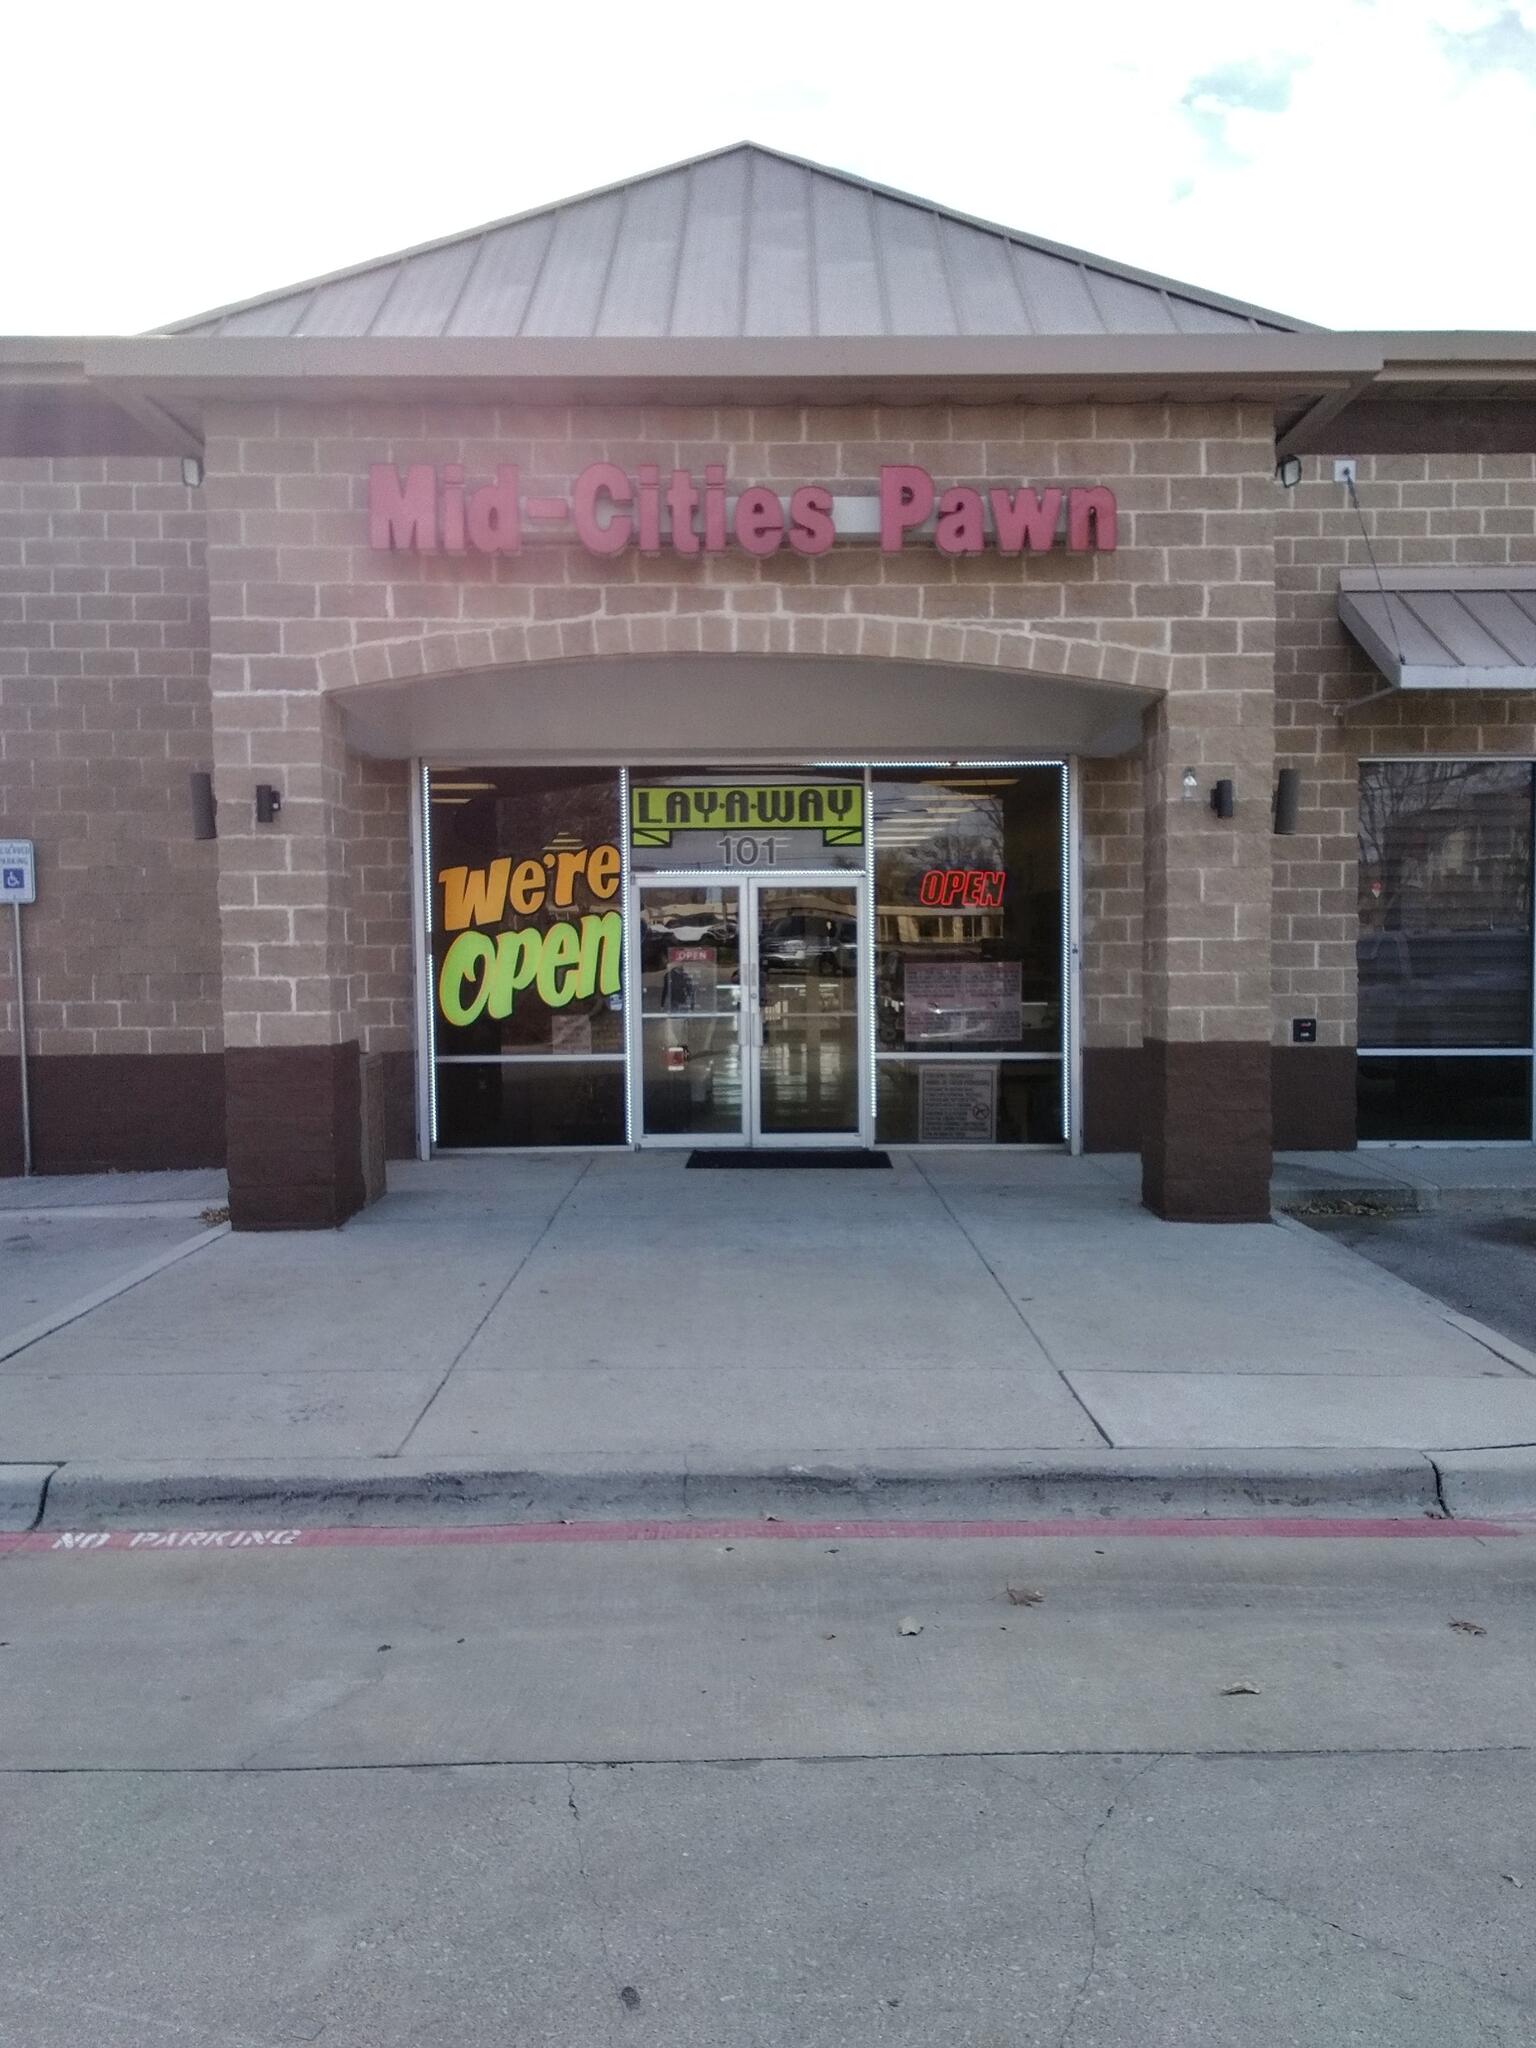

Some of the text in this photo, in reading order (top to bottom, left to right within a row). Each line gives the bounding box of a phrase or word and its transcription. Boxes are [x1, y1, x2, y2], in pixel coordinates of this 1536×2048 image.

[369, 463, 1117, 555] Mid-Cities Pawn
[716, 835, 777, 866] 101
[438, 844, 621, 931] We're
[920, 870, 1006, 907] OPEN
[677, 950, 707, 961] OPEN
[51, 1530, 302, 1549] NO PARKING
